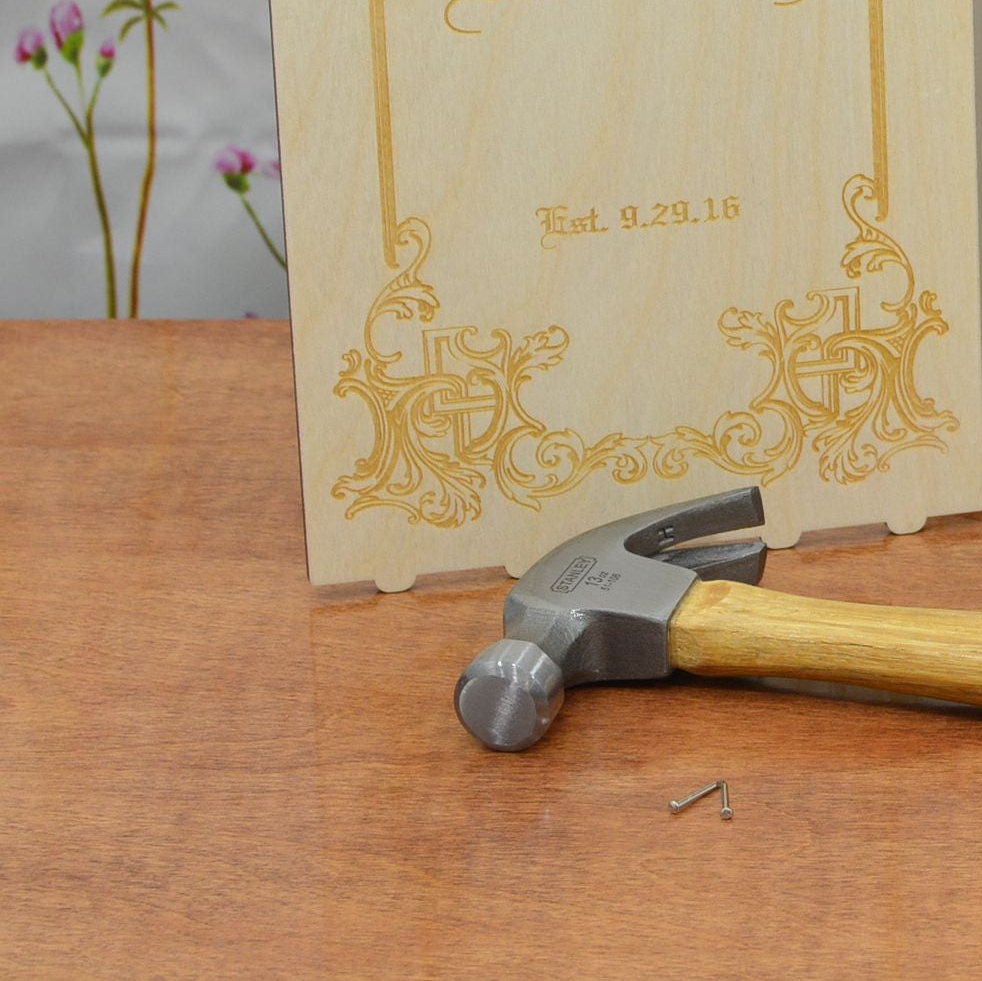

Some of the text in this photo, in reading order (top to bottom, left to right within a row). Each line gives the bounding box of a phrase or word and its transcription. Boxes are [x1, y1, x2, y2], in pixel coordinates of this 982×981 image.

[535, 195, 741, 250] Est. 9.29.16
[555, 556, 594, 592] STANLEY
